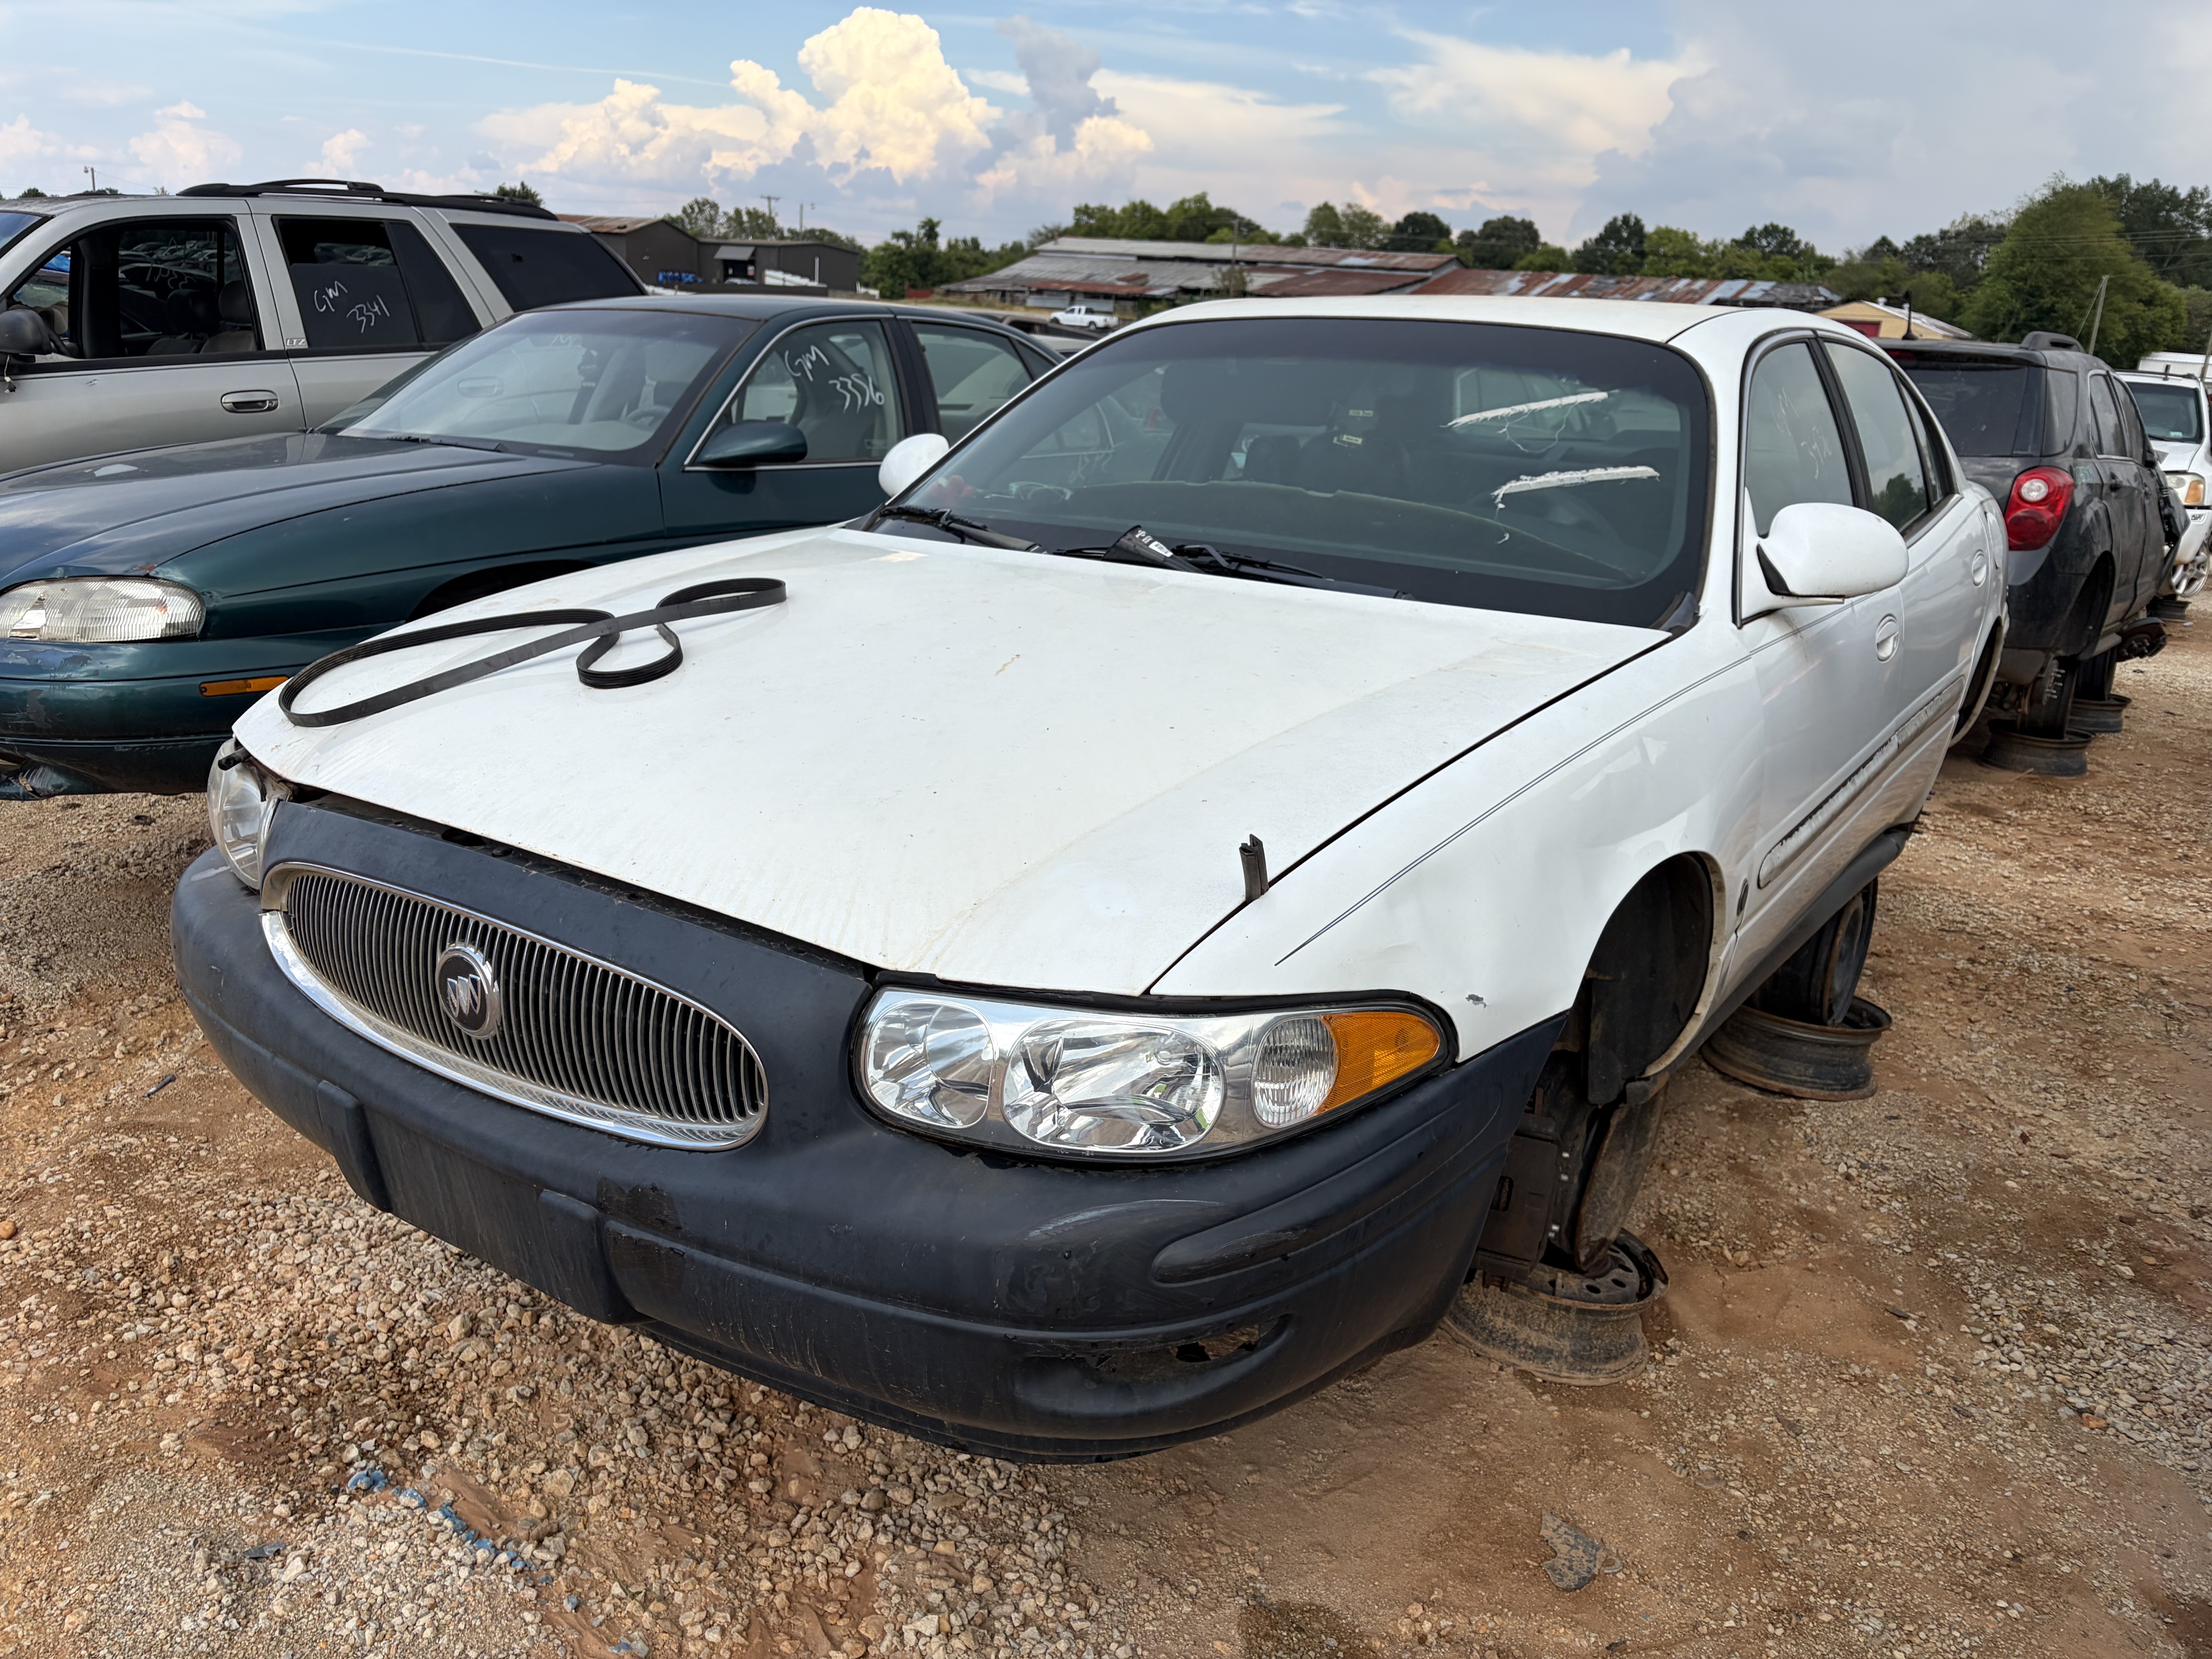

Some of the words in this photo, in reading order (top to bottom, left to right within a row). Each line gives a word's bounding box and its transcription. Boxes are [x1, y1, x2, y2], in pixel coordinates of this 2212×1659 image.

[314, 280, 348, 312] GM
[346, 294, 390, 333] 3341
[286, 338, 306, 347] LTZ
[784, 345, 830, 382] GM
[828, 373, 885, 414] 3356
